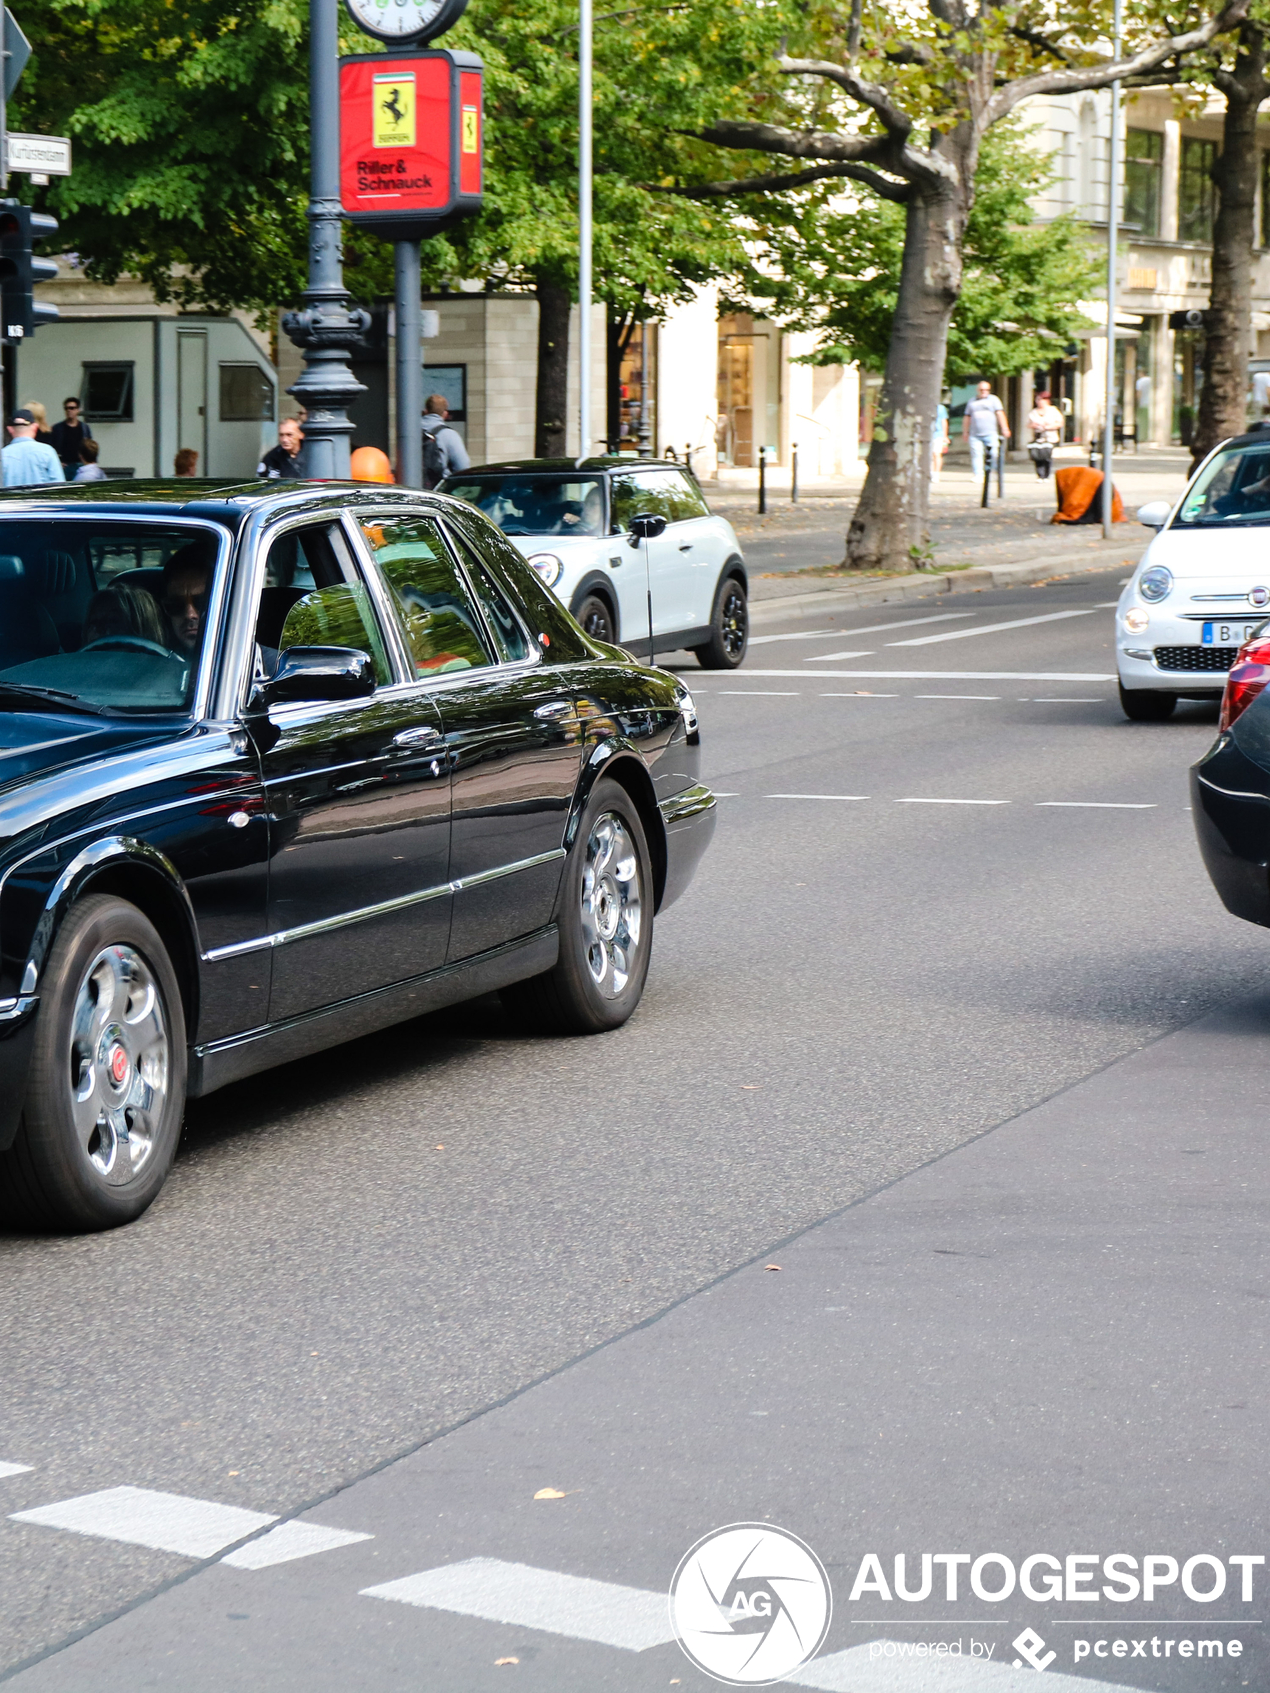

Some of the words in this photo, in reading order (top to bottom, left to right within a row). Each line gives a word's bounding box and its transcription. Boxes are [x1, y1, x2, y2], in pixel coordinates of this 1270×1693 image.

[357, 161, 395, 175] Riller
[396, 159, 407, 174] &
[358, 174, 433, 192] Schnauck
[7, 324, 24, 337] K6
[1220, 625, 1231, 641] B
